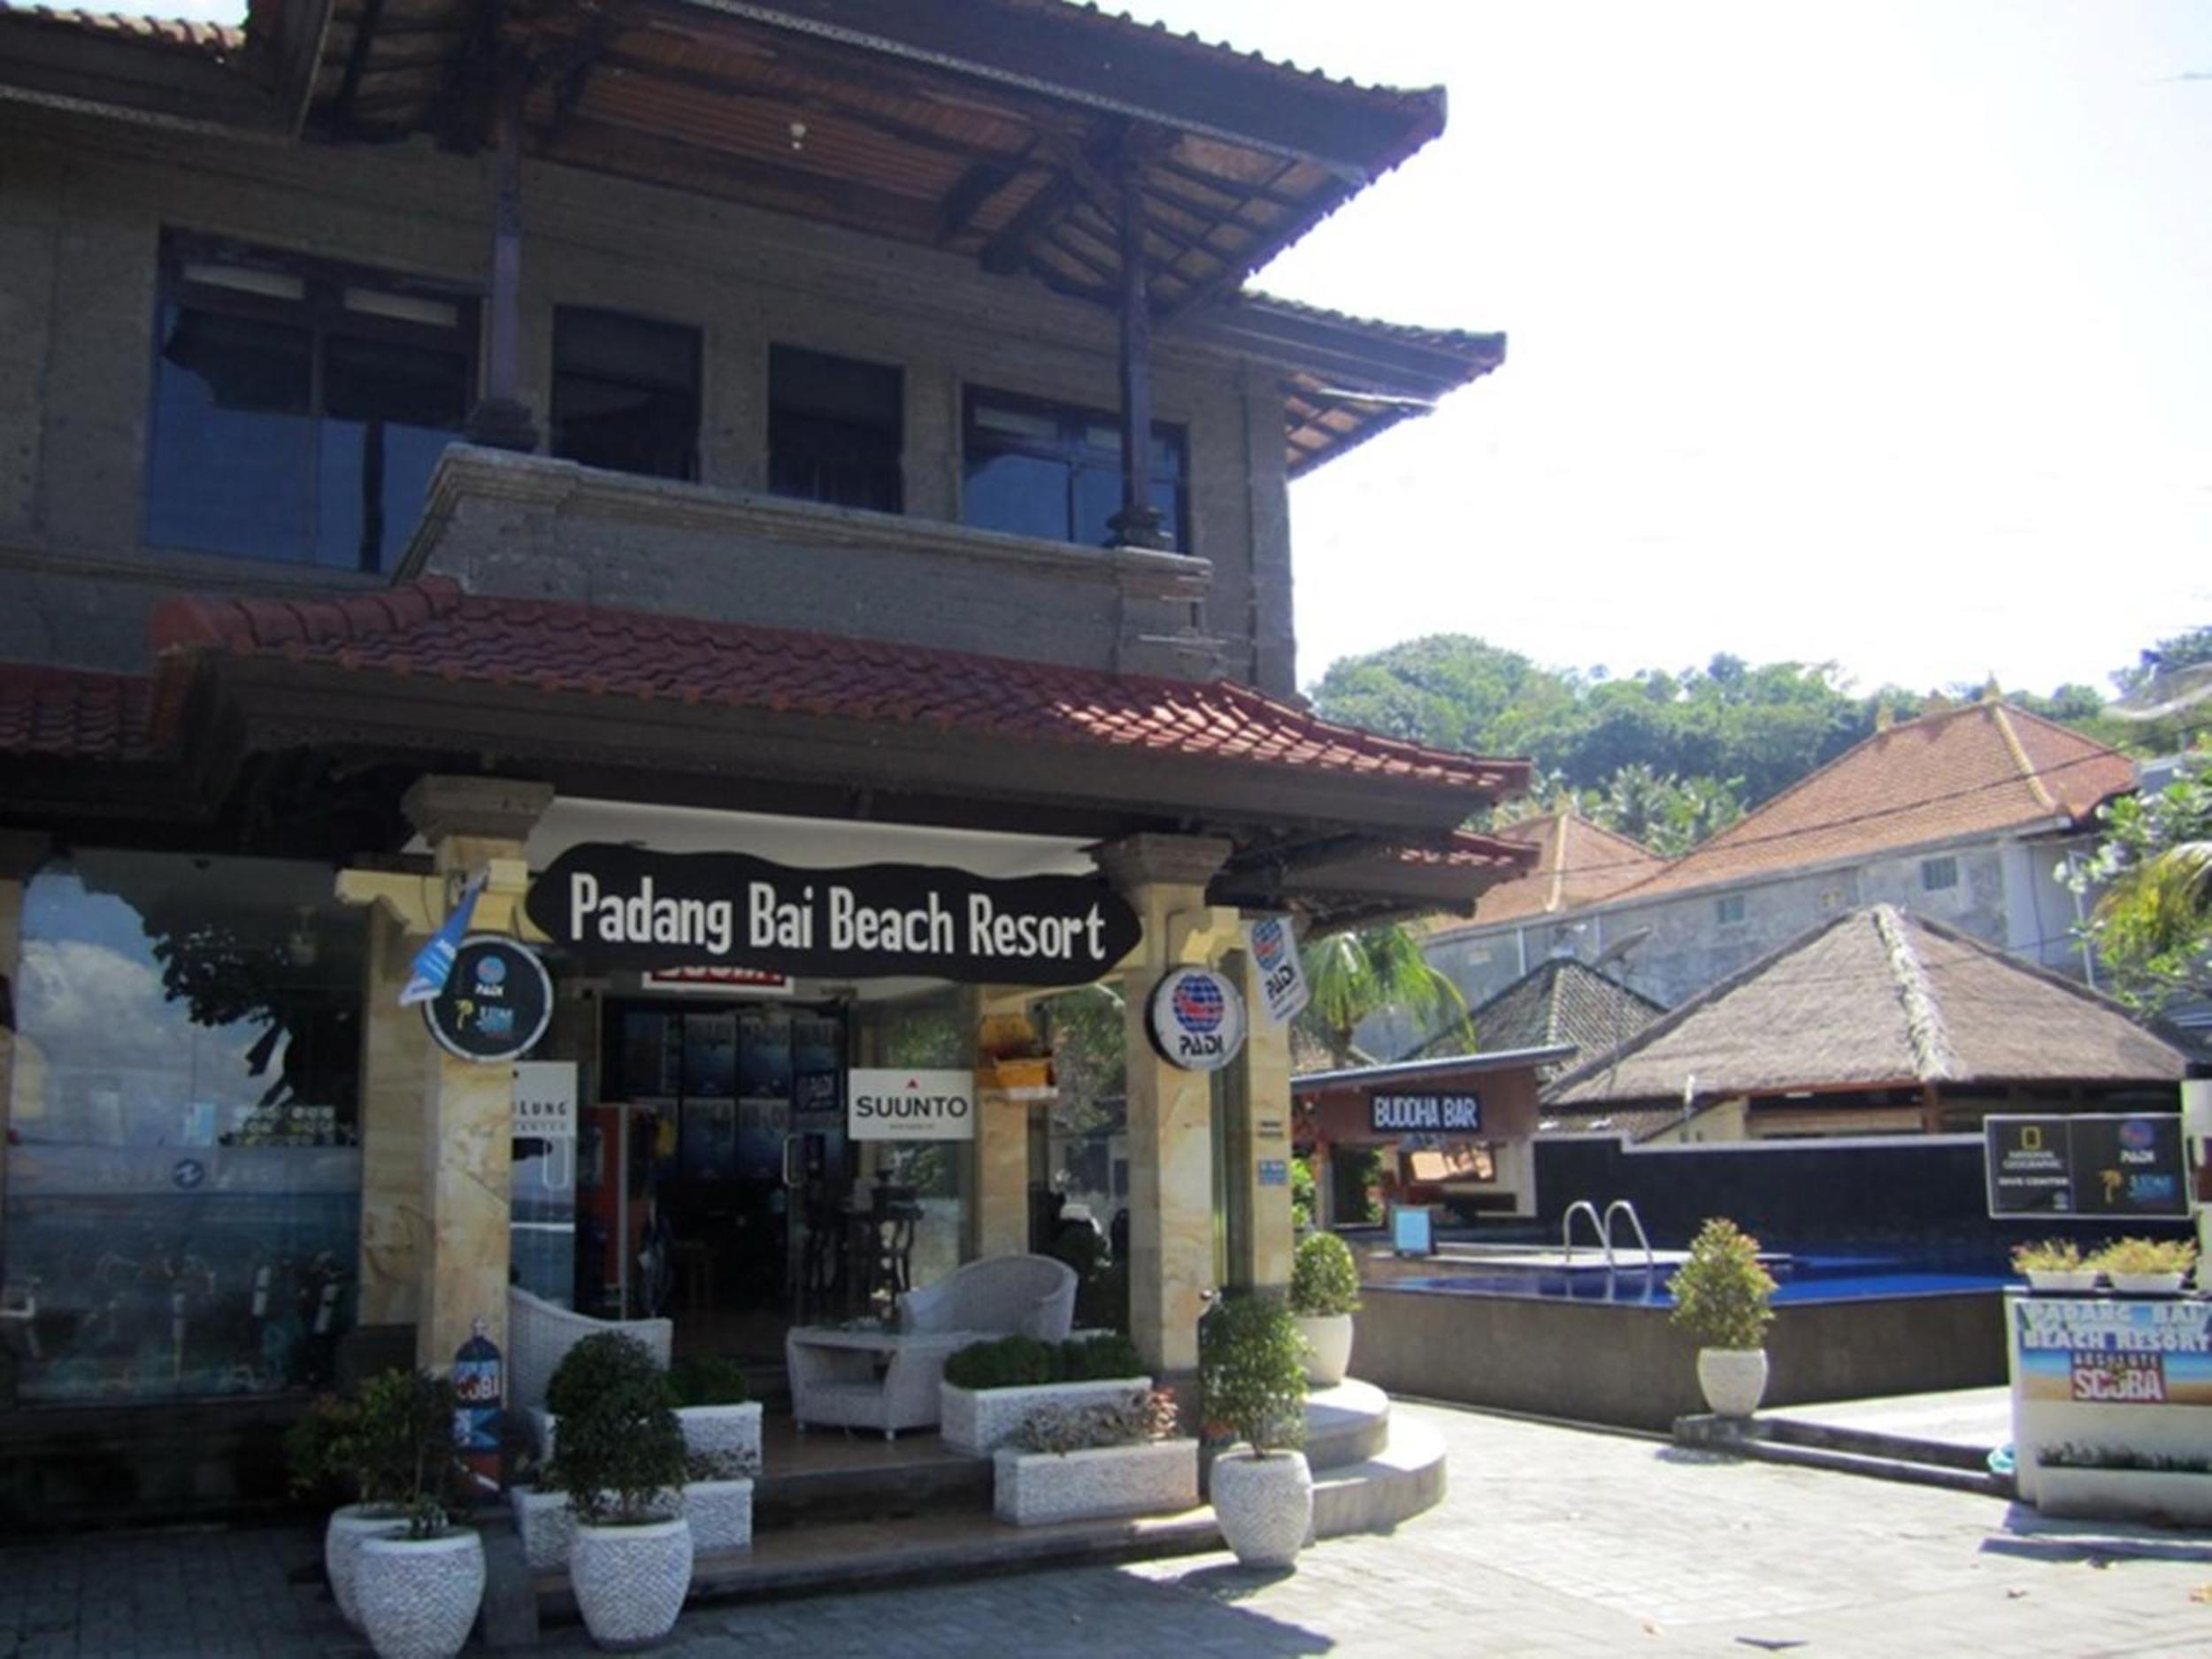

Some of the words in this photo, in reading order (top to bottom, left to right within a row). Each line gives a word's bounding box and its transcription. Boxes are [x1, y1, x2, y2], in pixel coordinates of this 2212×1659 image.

[570, 872, 733, 954] Padang
[749, 881, 813, 949] Bai
[829, 887, 955, 955] Beach
[969, 893, 1106, 961] Resort
[1179, 1034, 1224, 1056] PADI
[856, 1094, 968, 1118] SUUNTO
[1374, 1096, 1440, 1128] BUDDHA
[1443, 1098, 1478, 1128] BAR
[2025, 1303, 2131, 1323] PADANG
[2152, 1304, 2198, 1325] BAI
[2024, 1329, 2104, 1348] BEACH
[2116, 1328, 2208, 1352] RESORT
[2075, 1368, 2163, 1400] SCUBA
